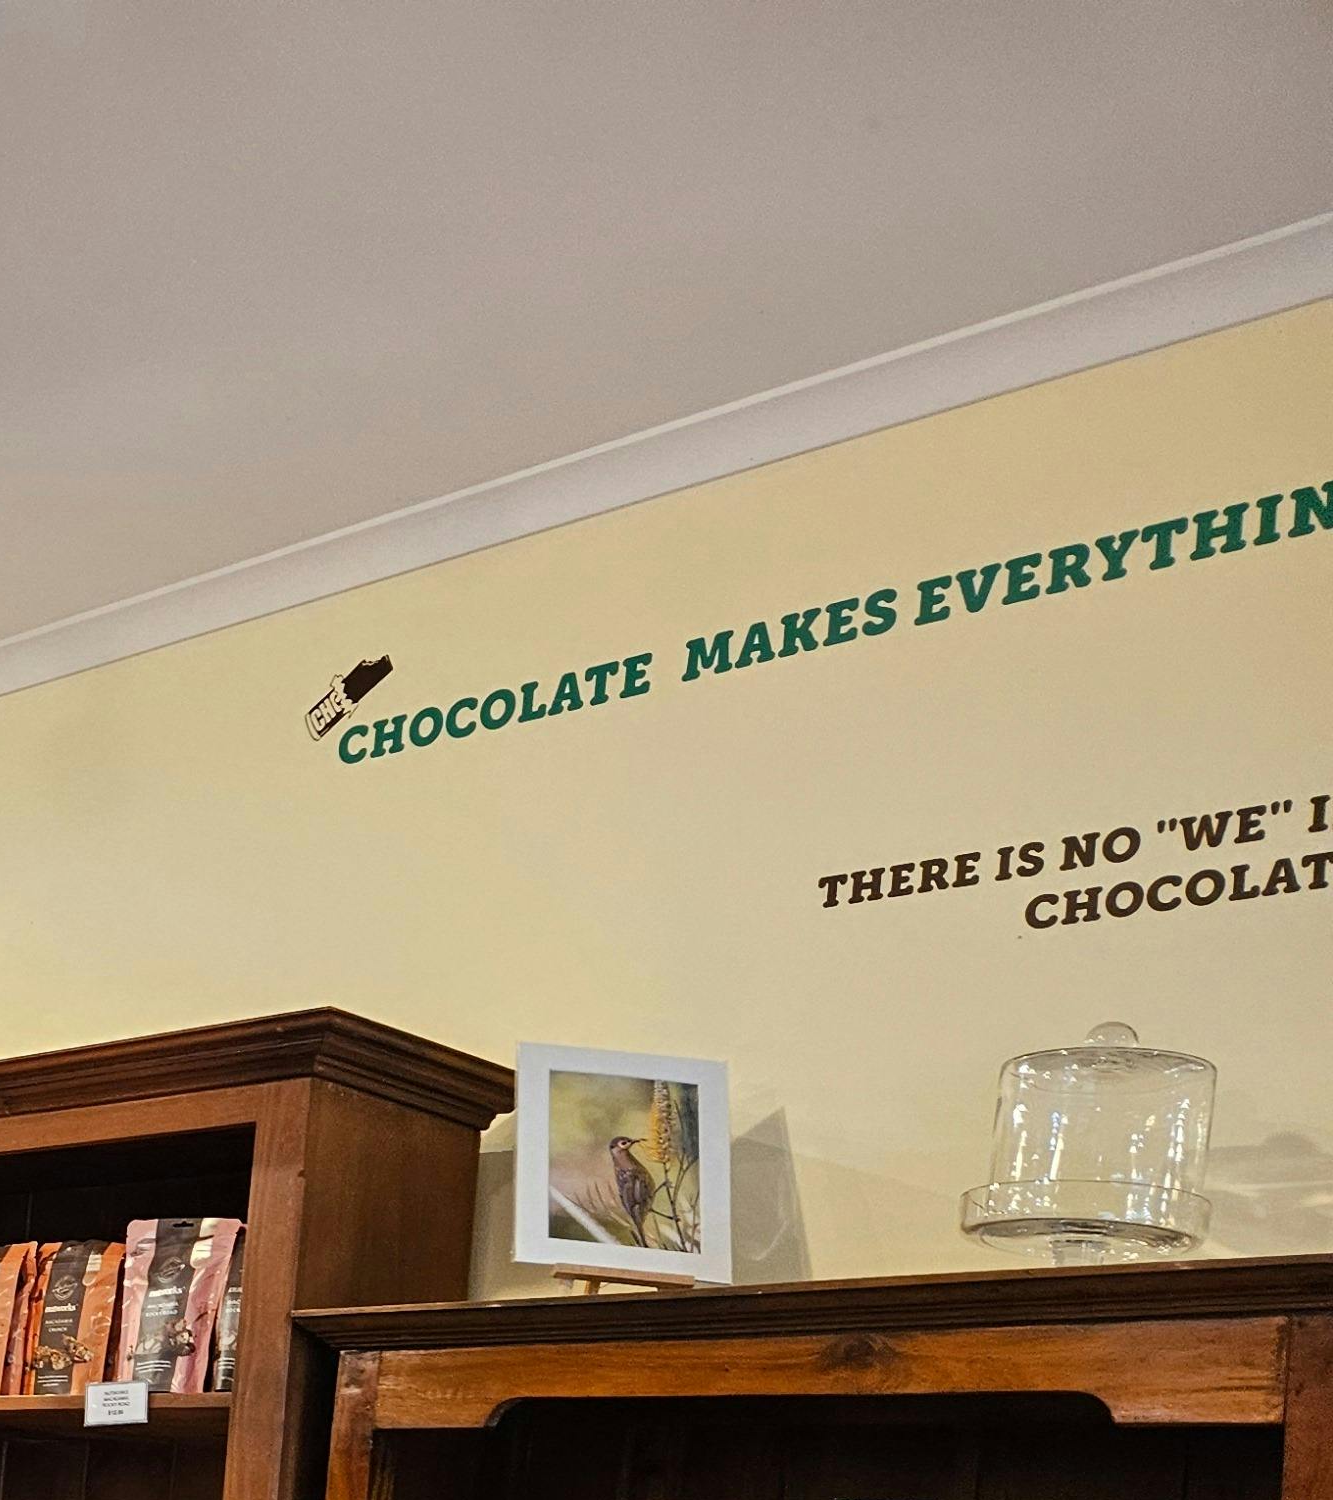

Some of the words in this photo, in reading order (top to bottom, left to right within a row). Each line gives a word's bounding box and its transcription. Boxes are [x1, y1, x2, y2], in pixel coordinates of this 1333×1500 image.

[338, 652, 653, 764] CHOCOLATE
[681, 588, 898, 682] MAKES
[818, 851, 981, 908] THERE
[994, 841, 1045, 882] IS
[1059, 827, 1142, 872] NO
[1156, 799, 1294, 852] "WE"
